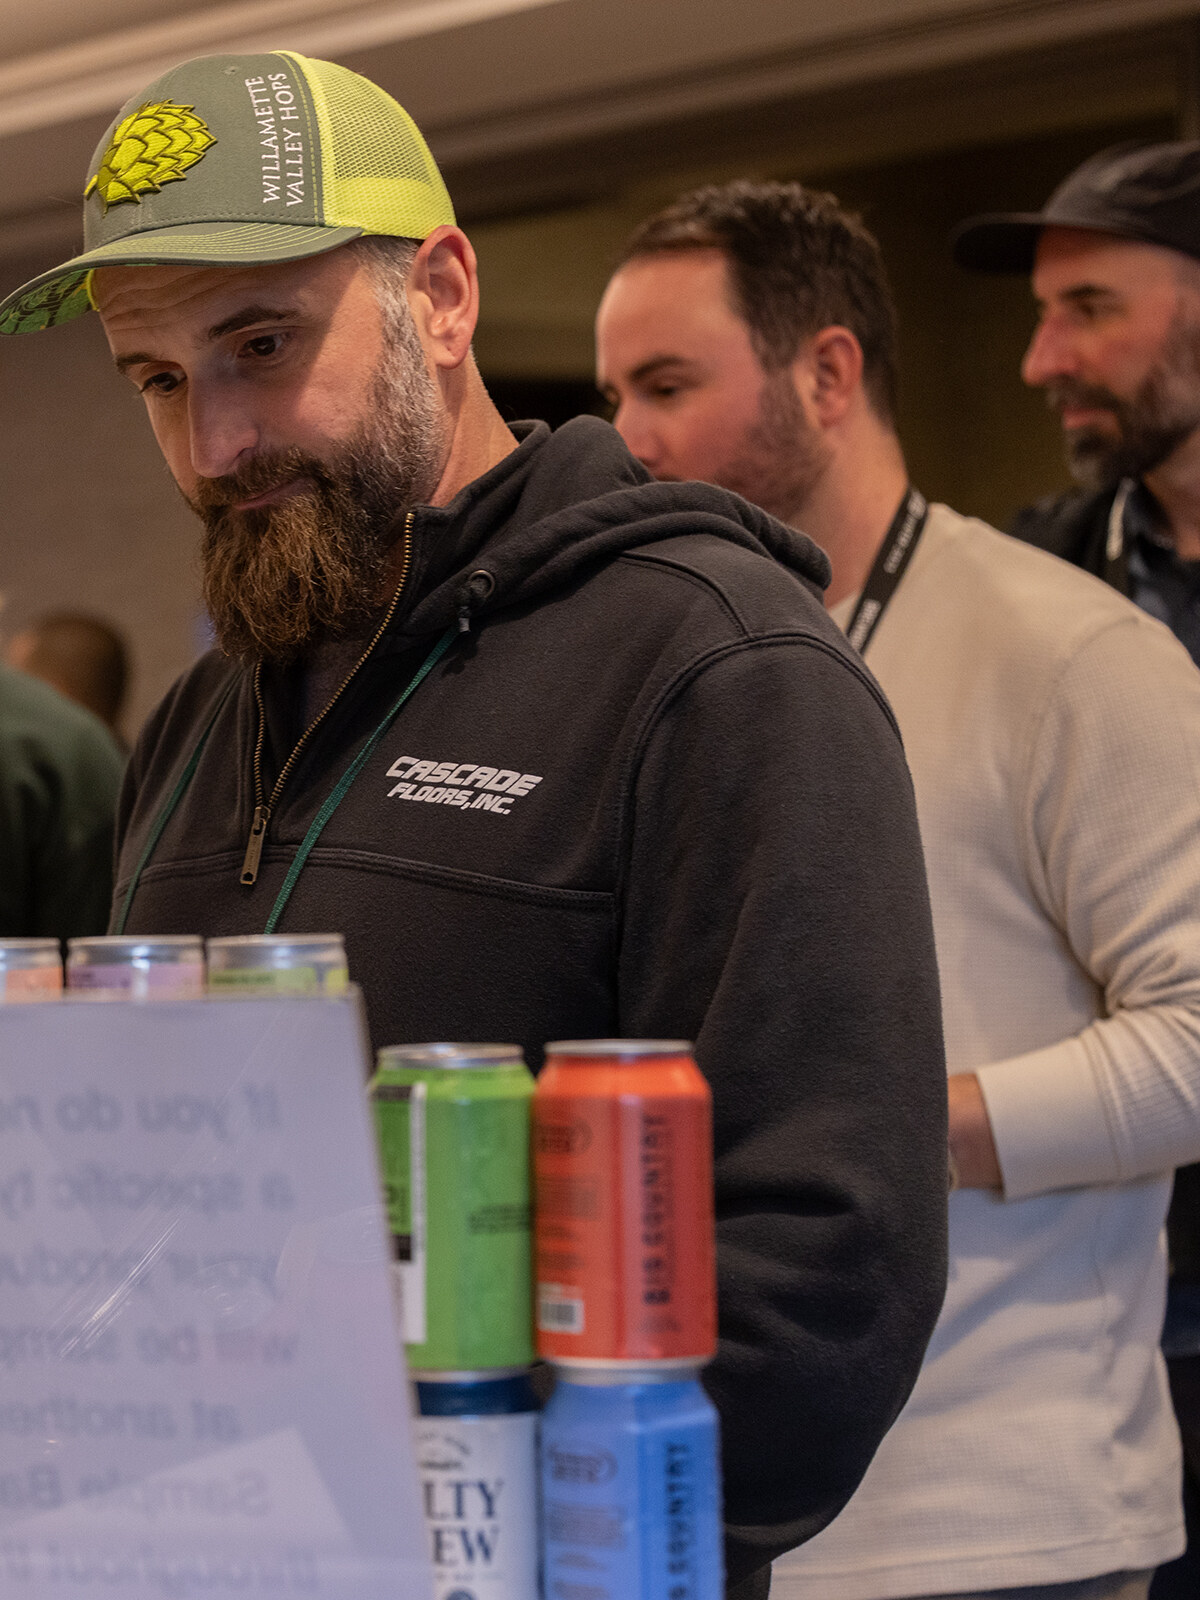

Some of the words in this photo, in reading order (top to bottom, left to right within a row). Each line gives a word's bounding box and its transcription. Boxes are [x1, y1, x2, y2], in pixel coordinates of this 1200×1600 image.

[267, 73, 300, 121] HOPS
[245, 76, 281, 203] WILLAMETTE
[282, 127, 305, 207] VALLEY
[385, 755, 543, 797] CASCADE
